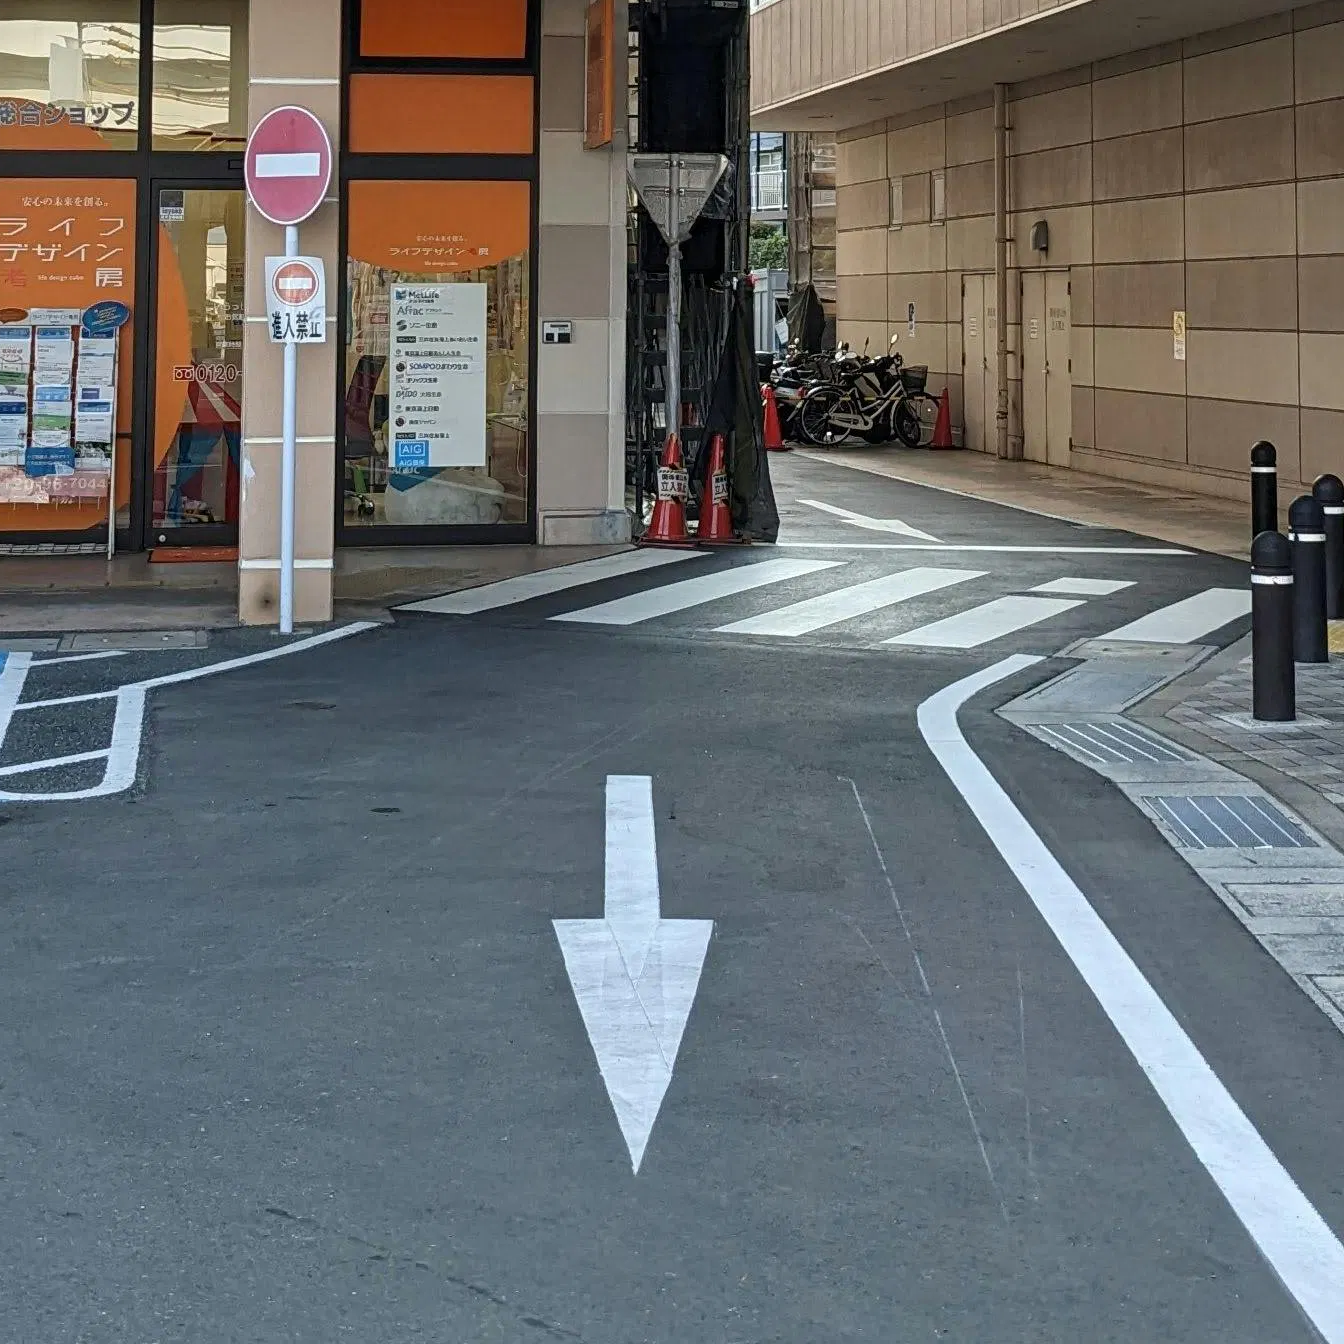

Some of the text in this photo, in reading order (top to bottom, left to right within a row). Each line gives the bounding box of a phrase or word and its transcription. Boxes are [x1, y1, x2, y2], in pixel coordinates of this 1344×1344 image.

[0, 217, 124, 236] ライフ
[409, 291, 440, 299] MetLife
[402, 445, 422, 454] AIG
